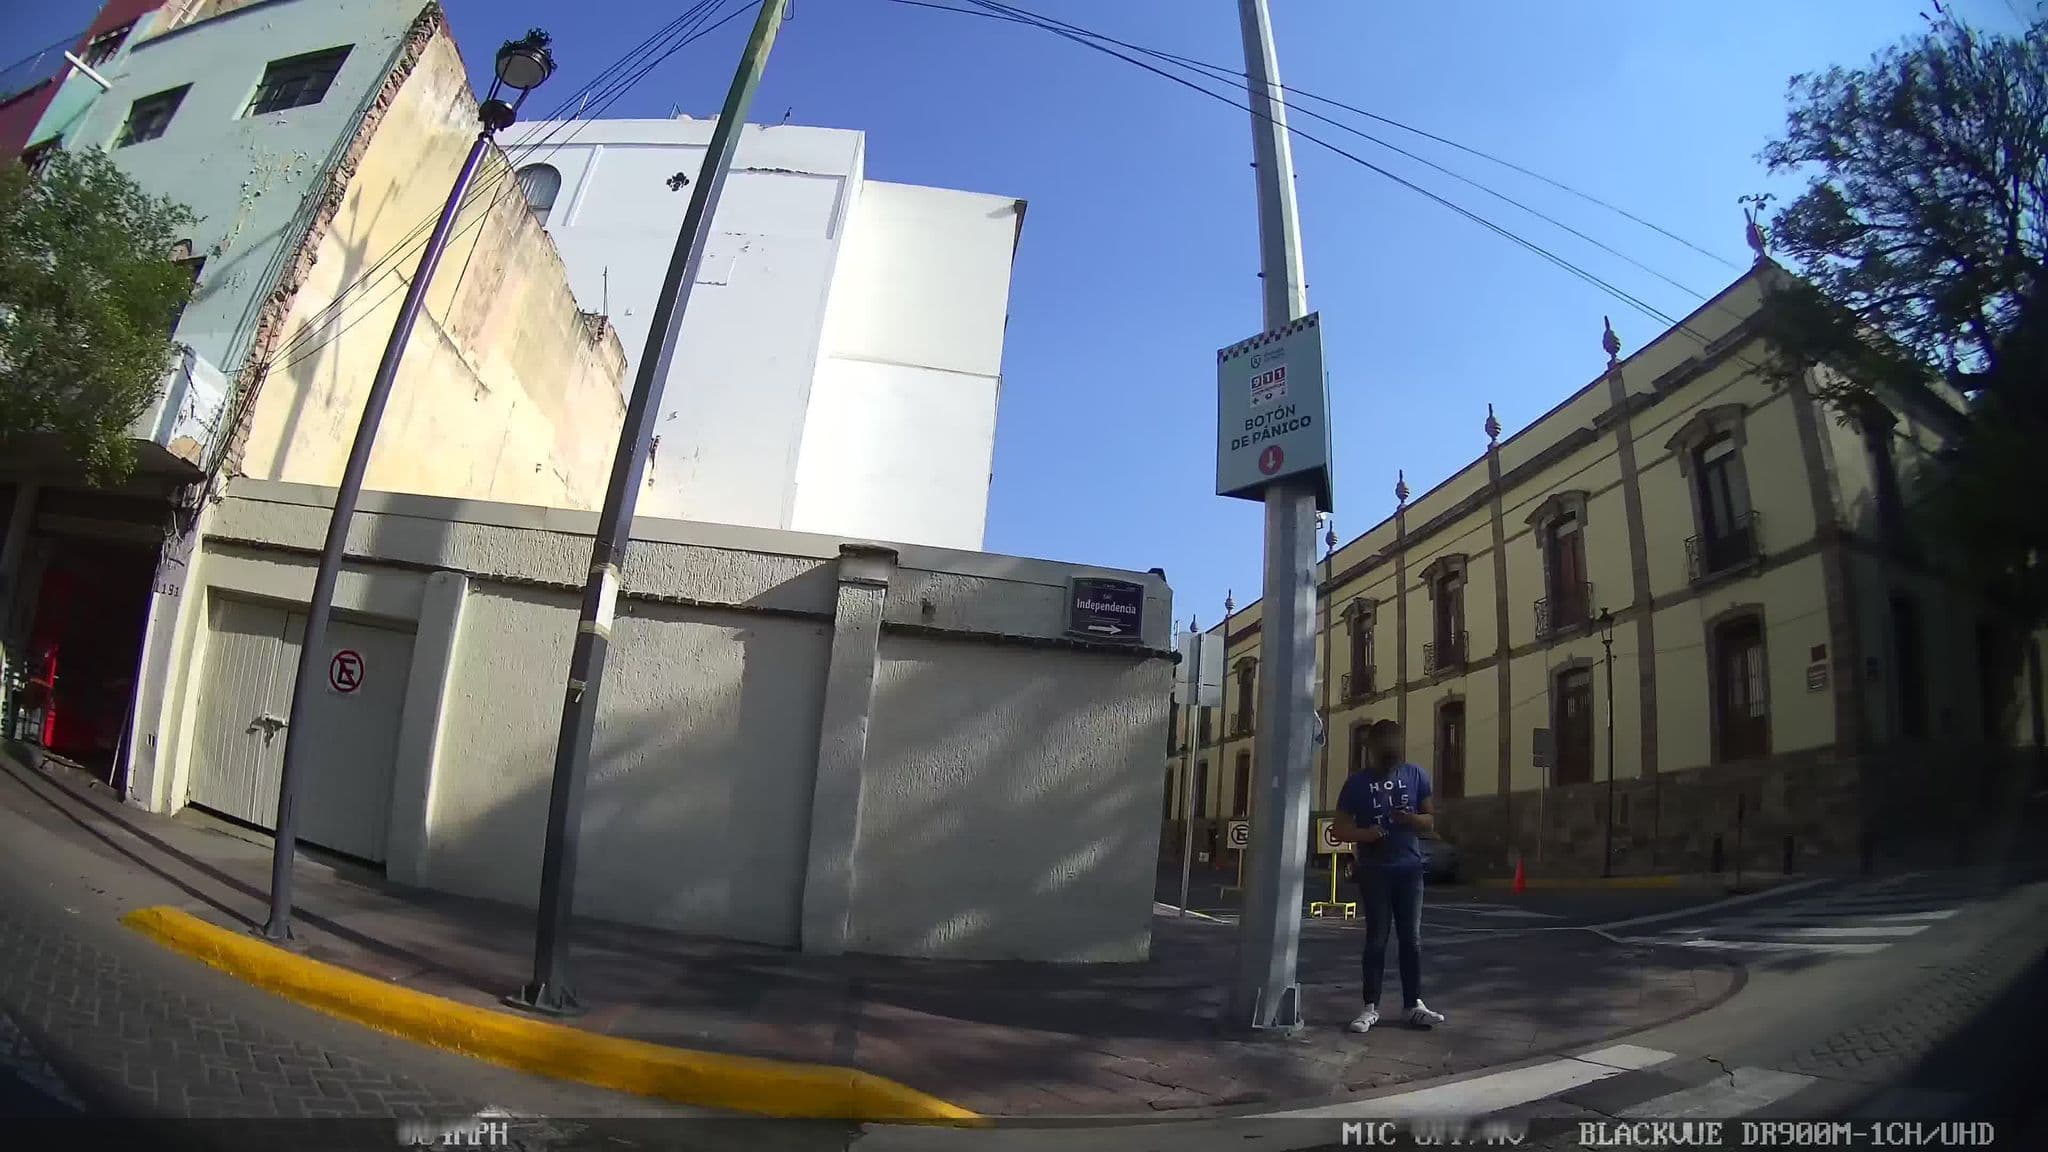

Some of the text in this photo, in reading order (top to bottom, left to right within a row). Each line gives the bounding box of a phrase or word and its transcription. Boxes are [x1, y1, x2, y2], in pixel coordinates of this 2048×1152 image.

[1245, 404, 1296, 431] BOTÓN
[1231, 415, 1312, 451] DE PÁNICO
[1076, 598, 1137, 615] Independencia
[1369, 779, 1407, 793] HOL
[1373, 794, 1409, 809] LIS
